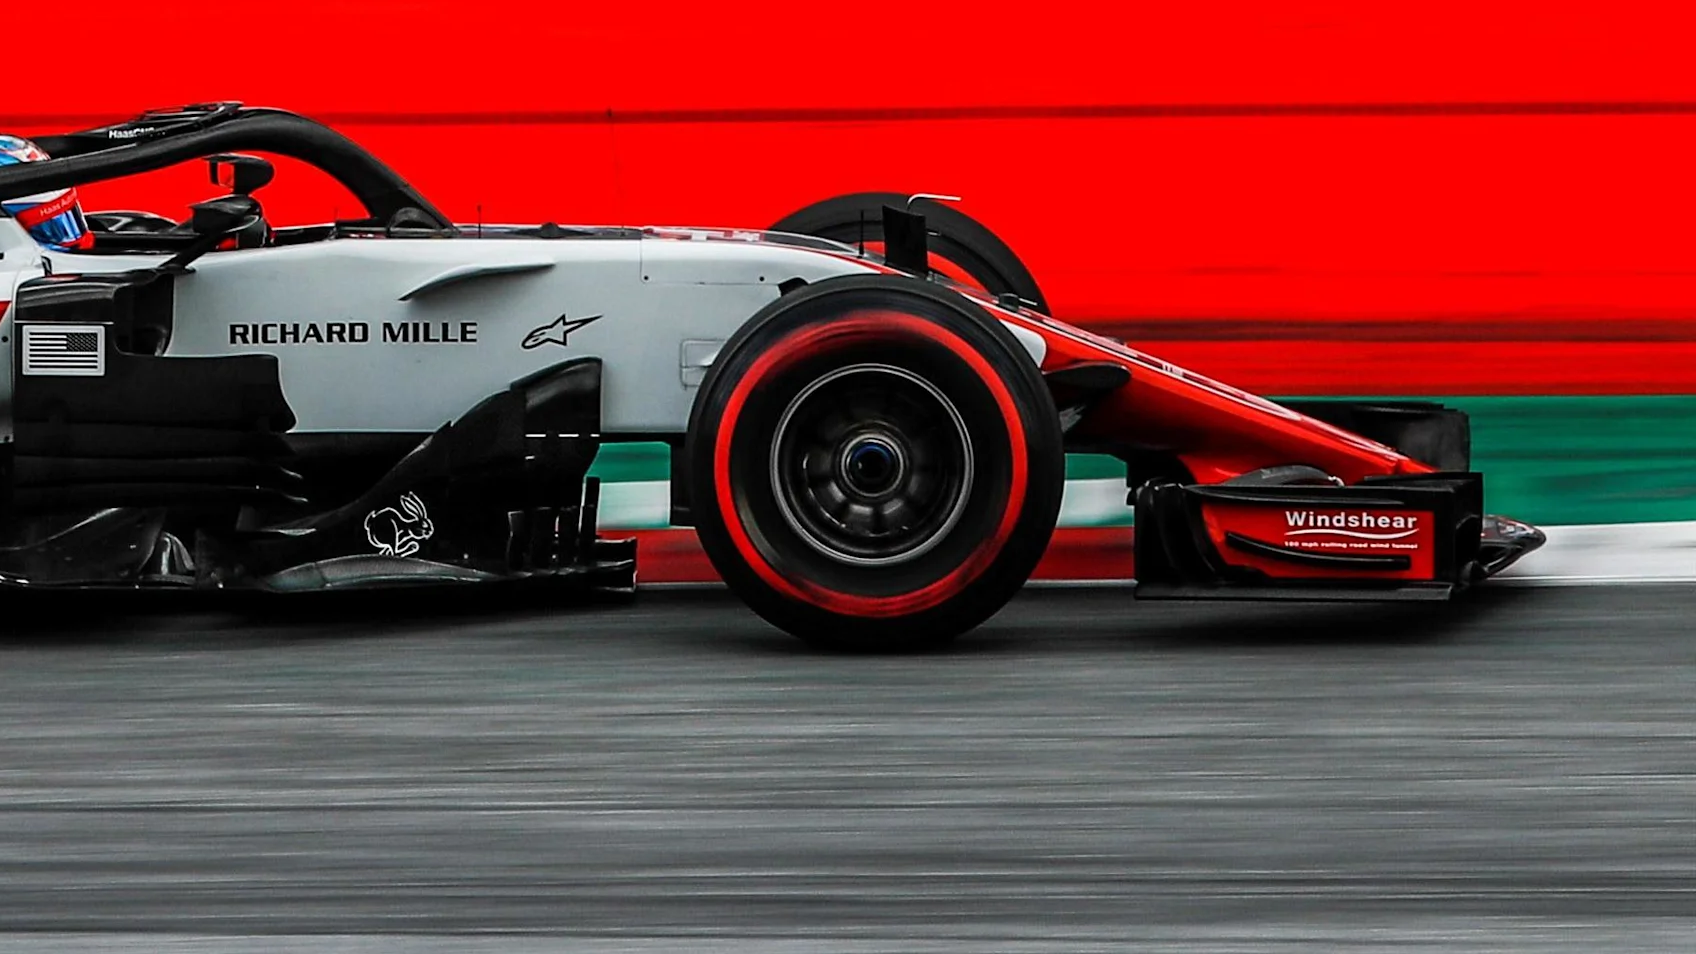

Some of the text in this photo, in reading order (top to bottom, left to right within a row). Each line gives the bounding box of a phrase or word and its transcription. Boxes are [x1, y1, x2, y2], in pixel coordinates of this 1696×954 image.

[229, 321, 478, 345] RICHARD MILLE
[1285, 511, 1417, 528] Windshear
